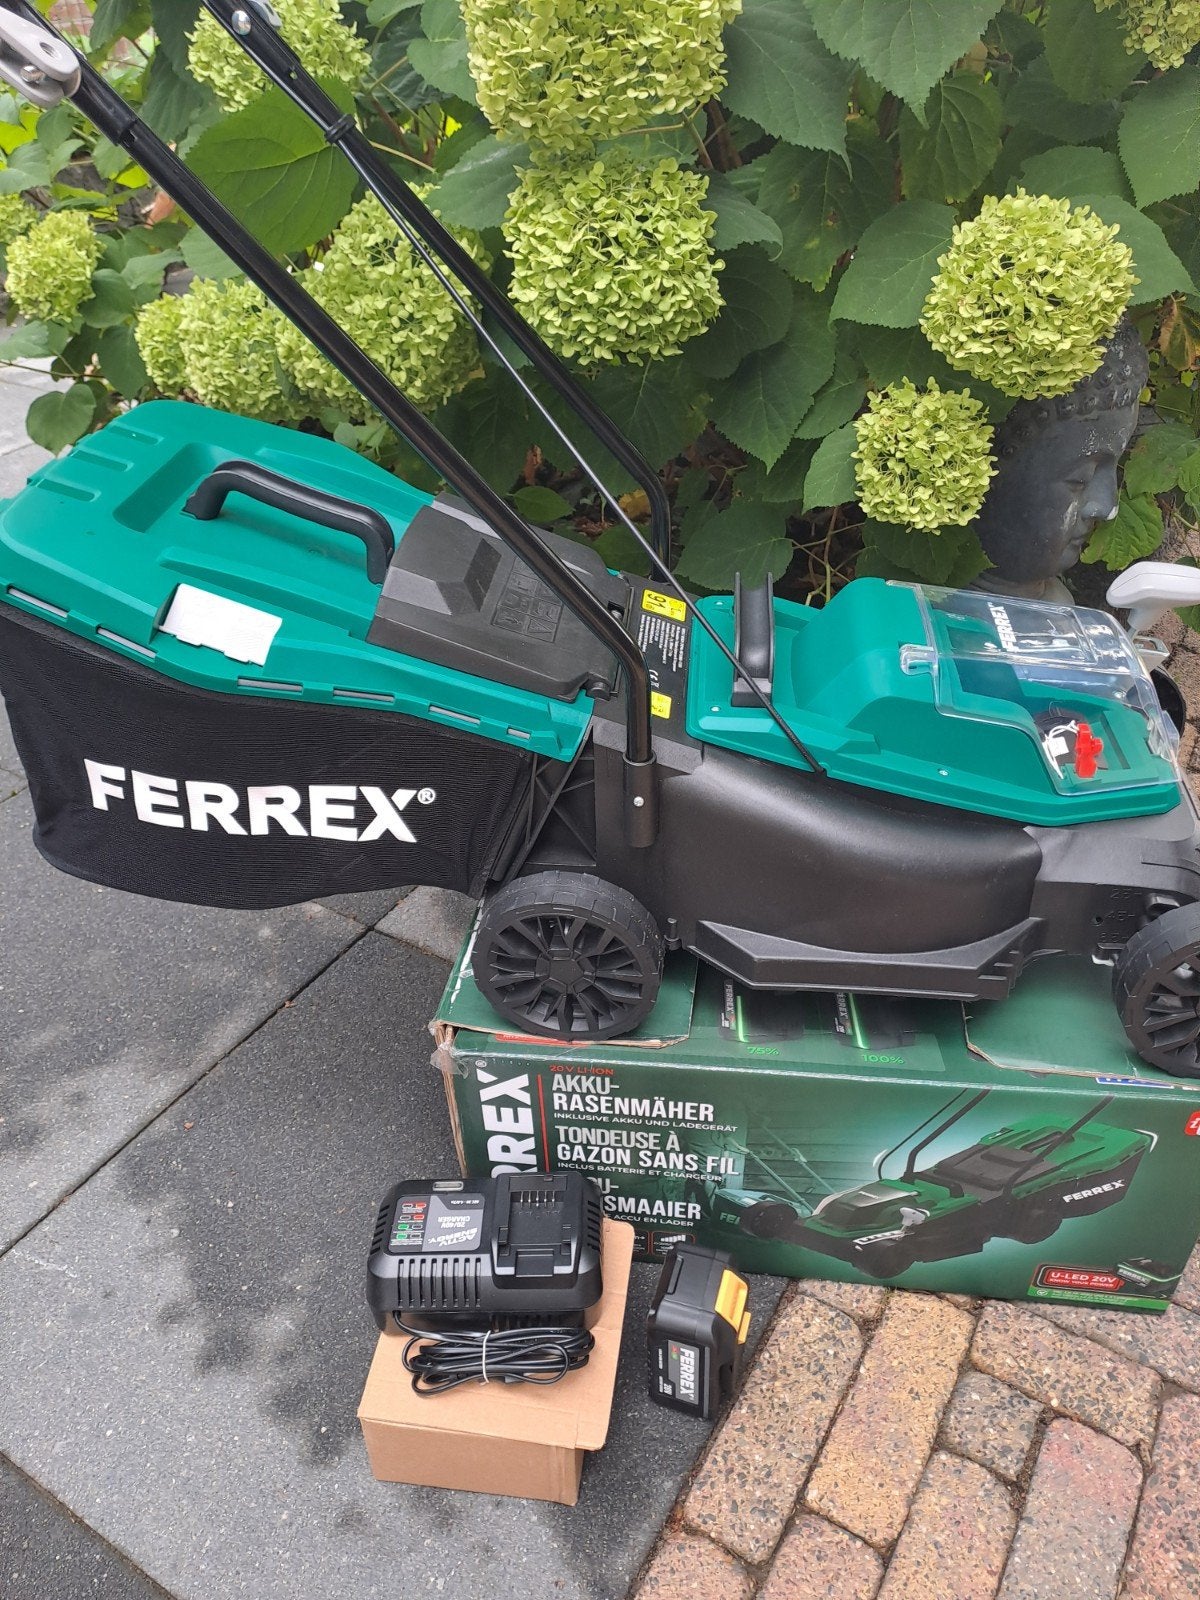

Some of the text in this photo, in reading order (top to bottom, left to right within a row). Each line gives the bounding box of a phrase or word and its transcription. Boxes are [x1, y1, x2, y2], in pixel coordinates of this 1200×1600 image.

[988, 602, 1019, 653] FERREX
[725, 984, 734, 1013] FERREX
[746, 1046, 781, 1056] 75%
[861, 1053, 905, 1064] 100%
[577, 1067, 614, 1076] LI-ION
[552, 1073, 620, 1095] AKKU-
[553, 1093, 715, 1122] RASENMÄHER
[553, 1112, 738, 1132] INKLUSIVE AKKU UND LADEGERÄT
[555, 1125, 681, 1152] TONDEUSE À
[556, 1143, 740, 1175] GAZON SANS FIL
[557, 1162, 595, 1171] INCLUS
[597, 1165, 646, 1175] BATTERIE
[663, 1171, 723, 1182] CHARGEUR
[1062, 1179, 1125, 1203] FERREX
[603, 1195, 702, 1220] SMAAIER
[613, 1214, 641, 1222] ACCU
[659, 1218, 695, 1227] LADER
[1050, 1271, 1118, 1283] U-LED 20V
[680, 1347, 695, 1399] FERREX
